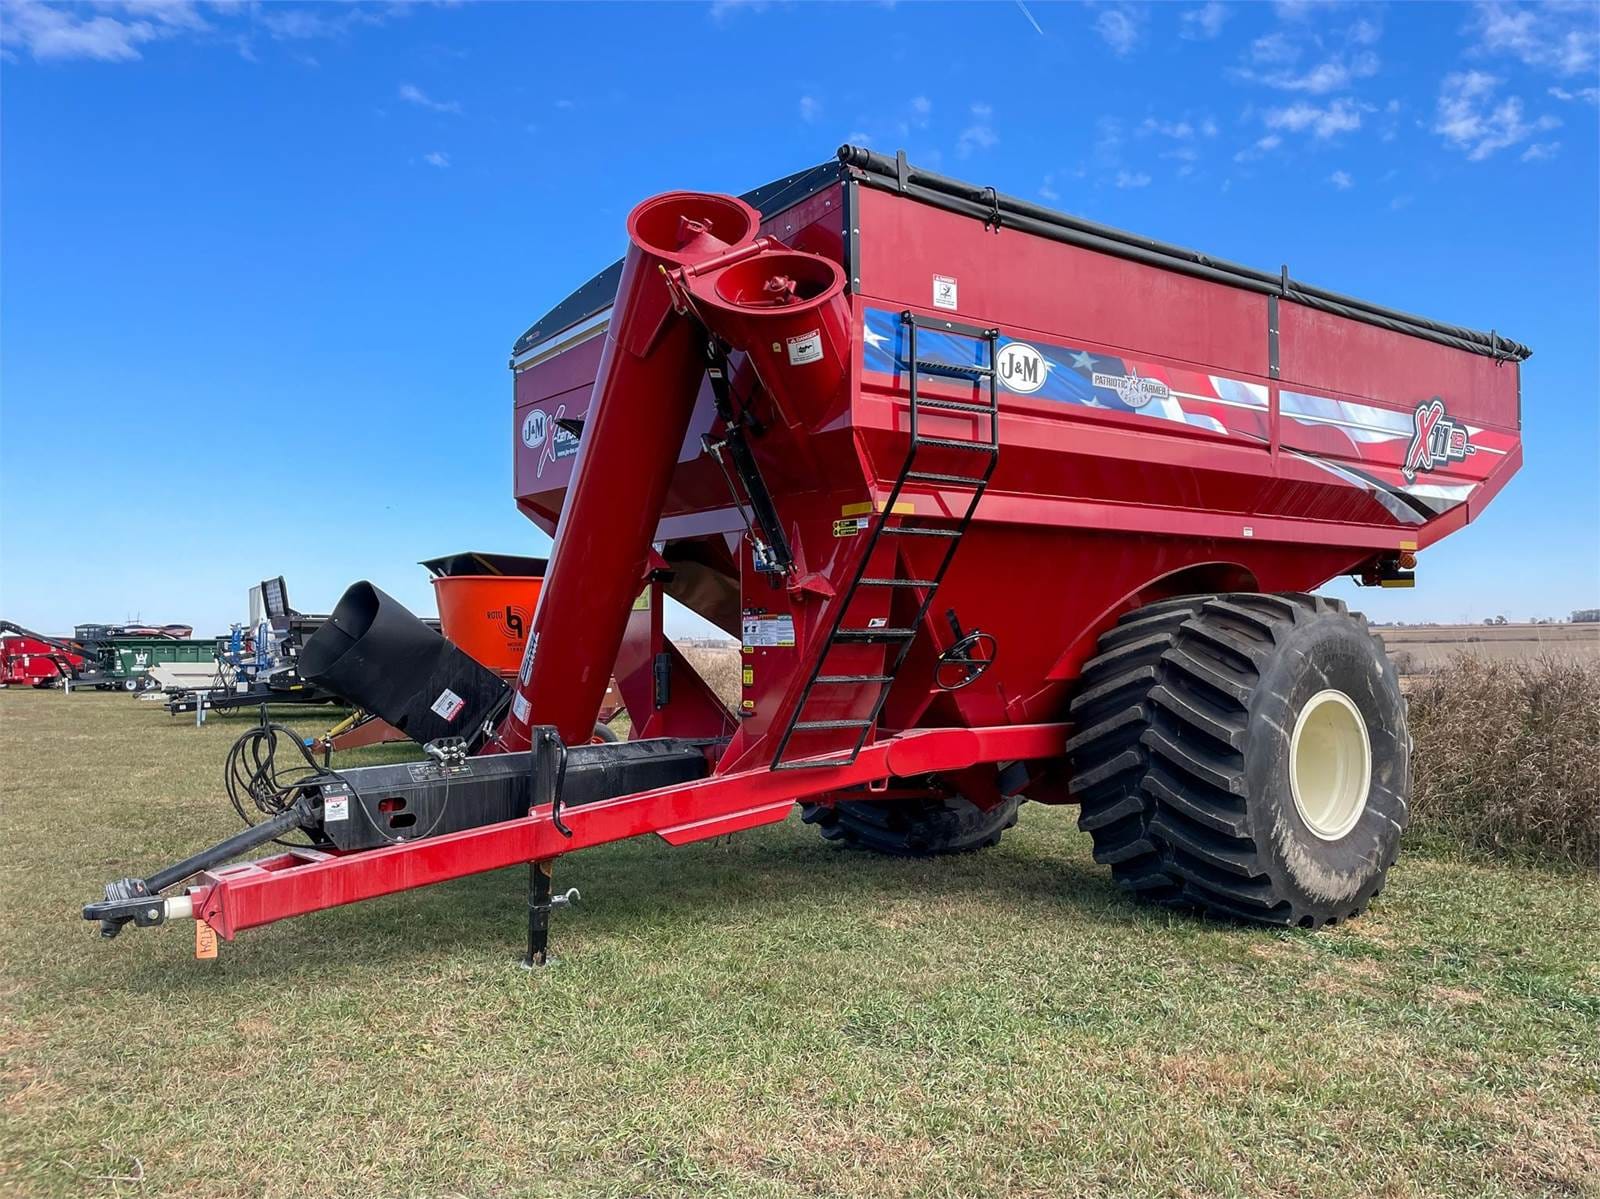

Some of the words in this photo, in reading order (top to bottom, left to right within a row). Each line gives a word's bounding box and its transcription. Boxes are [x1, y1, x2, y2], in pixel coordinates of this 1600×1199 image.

[1001, 352, 1039, 384] J&M
[1094, 375, 1128, 389] PATRIOTIC
[1141, 383, 1167, 396] FARMER
[524, 417, 544, 441] J&M
